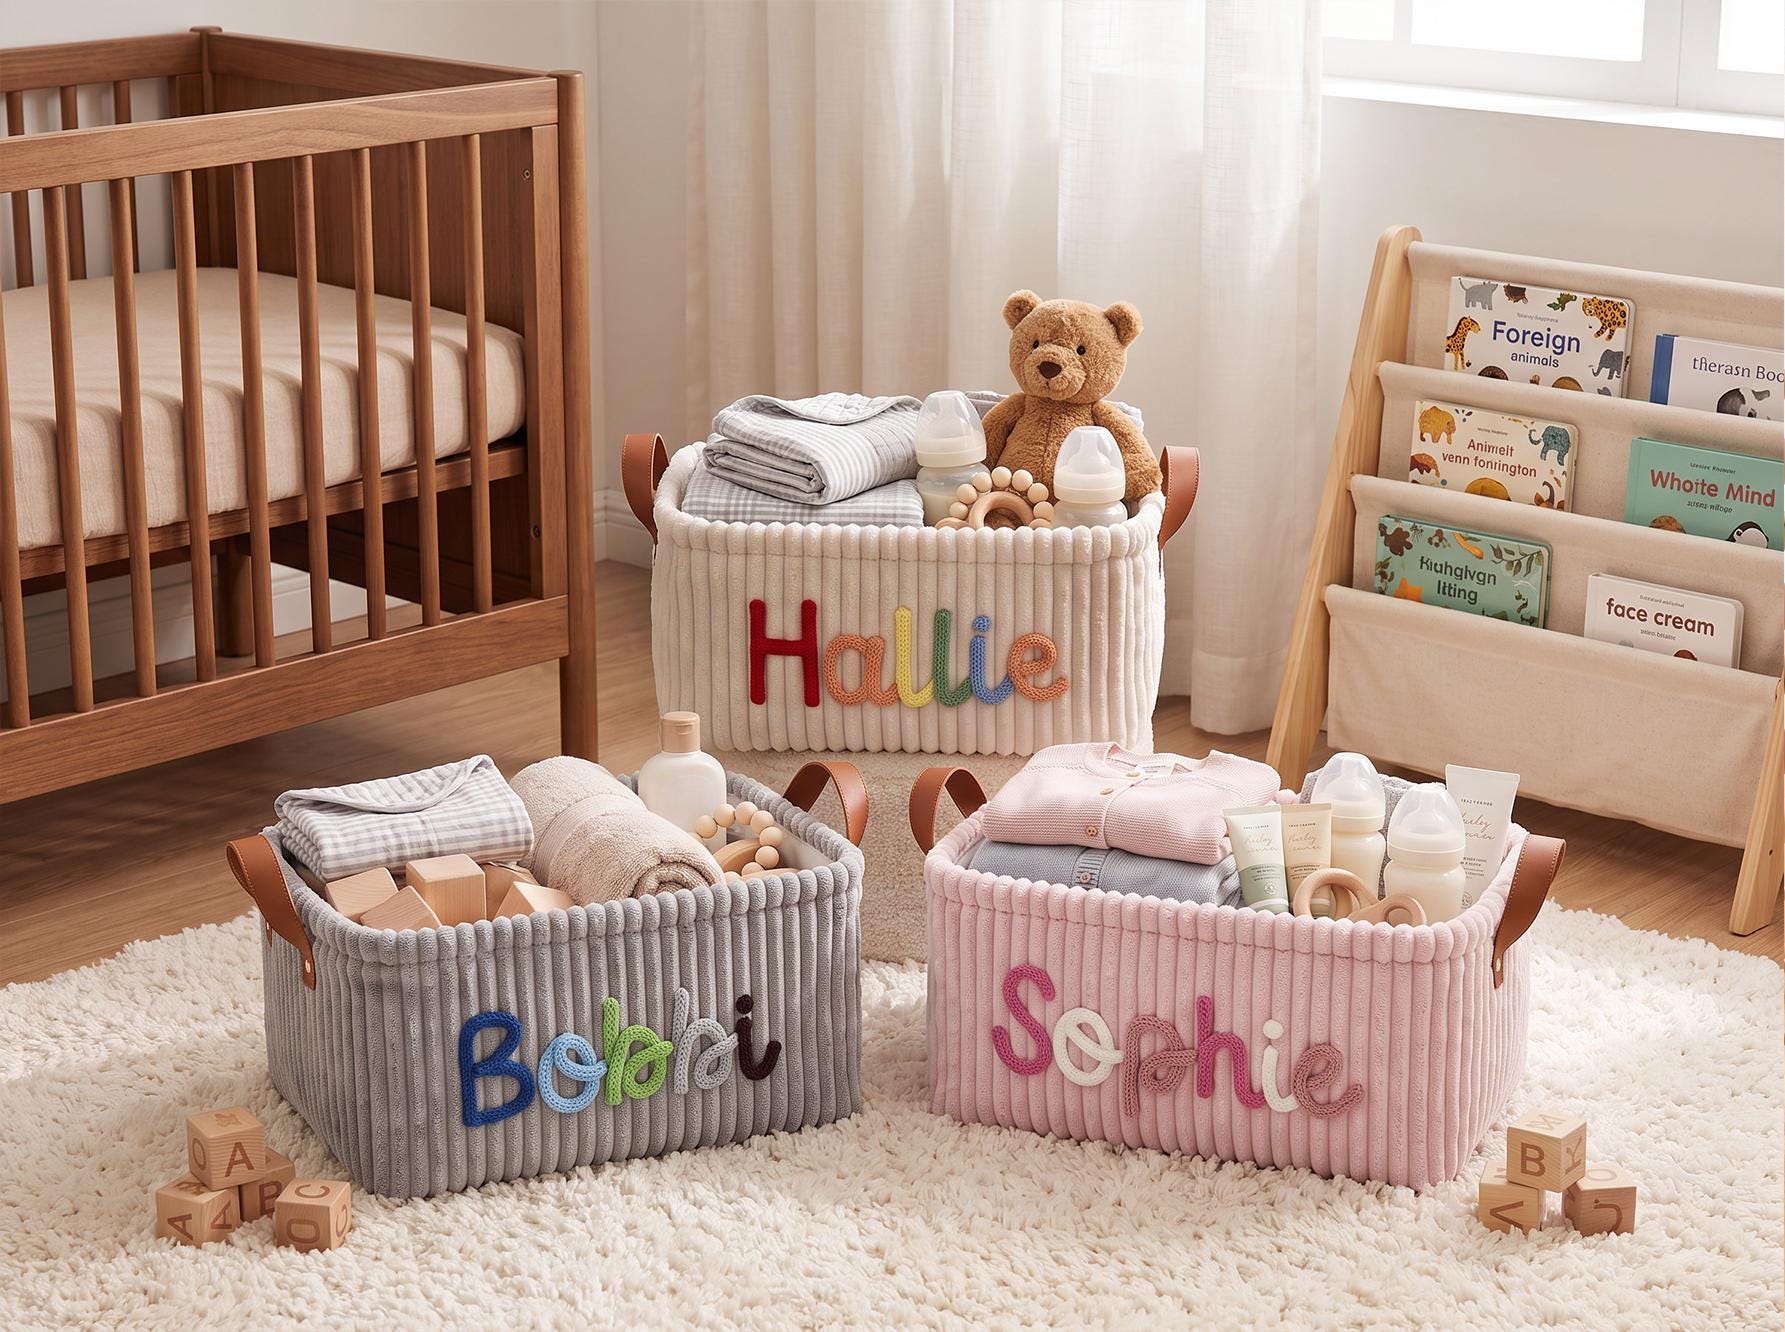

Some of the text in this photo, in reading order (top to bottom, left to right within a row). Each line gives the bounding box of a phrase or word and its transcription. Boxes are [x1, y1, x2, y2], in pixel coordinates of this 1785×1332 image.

[1492, 320, 1581, 355] Foreign
[1510, 352, 1560, 368] animals
[1442, 452, 1470, 466] venn
[1725, 483, 1776, 508] Mind
[1606, 597, 1648, 622] face
[1654, 612, 1715, 637] cream
[749, 599, 1070, 708] Hallie
[458, 987, 782, 1127] Bobbi
[991, 964, 1364, 1119] Sophie
[224, 1142, 255, 1178] A
[1520, 1142, 1546, 1177] B
[167, 1213, 194, 1241] A
